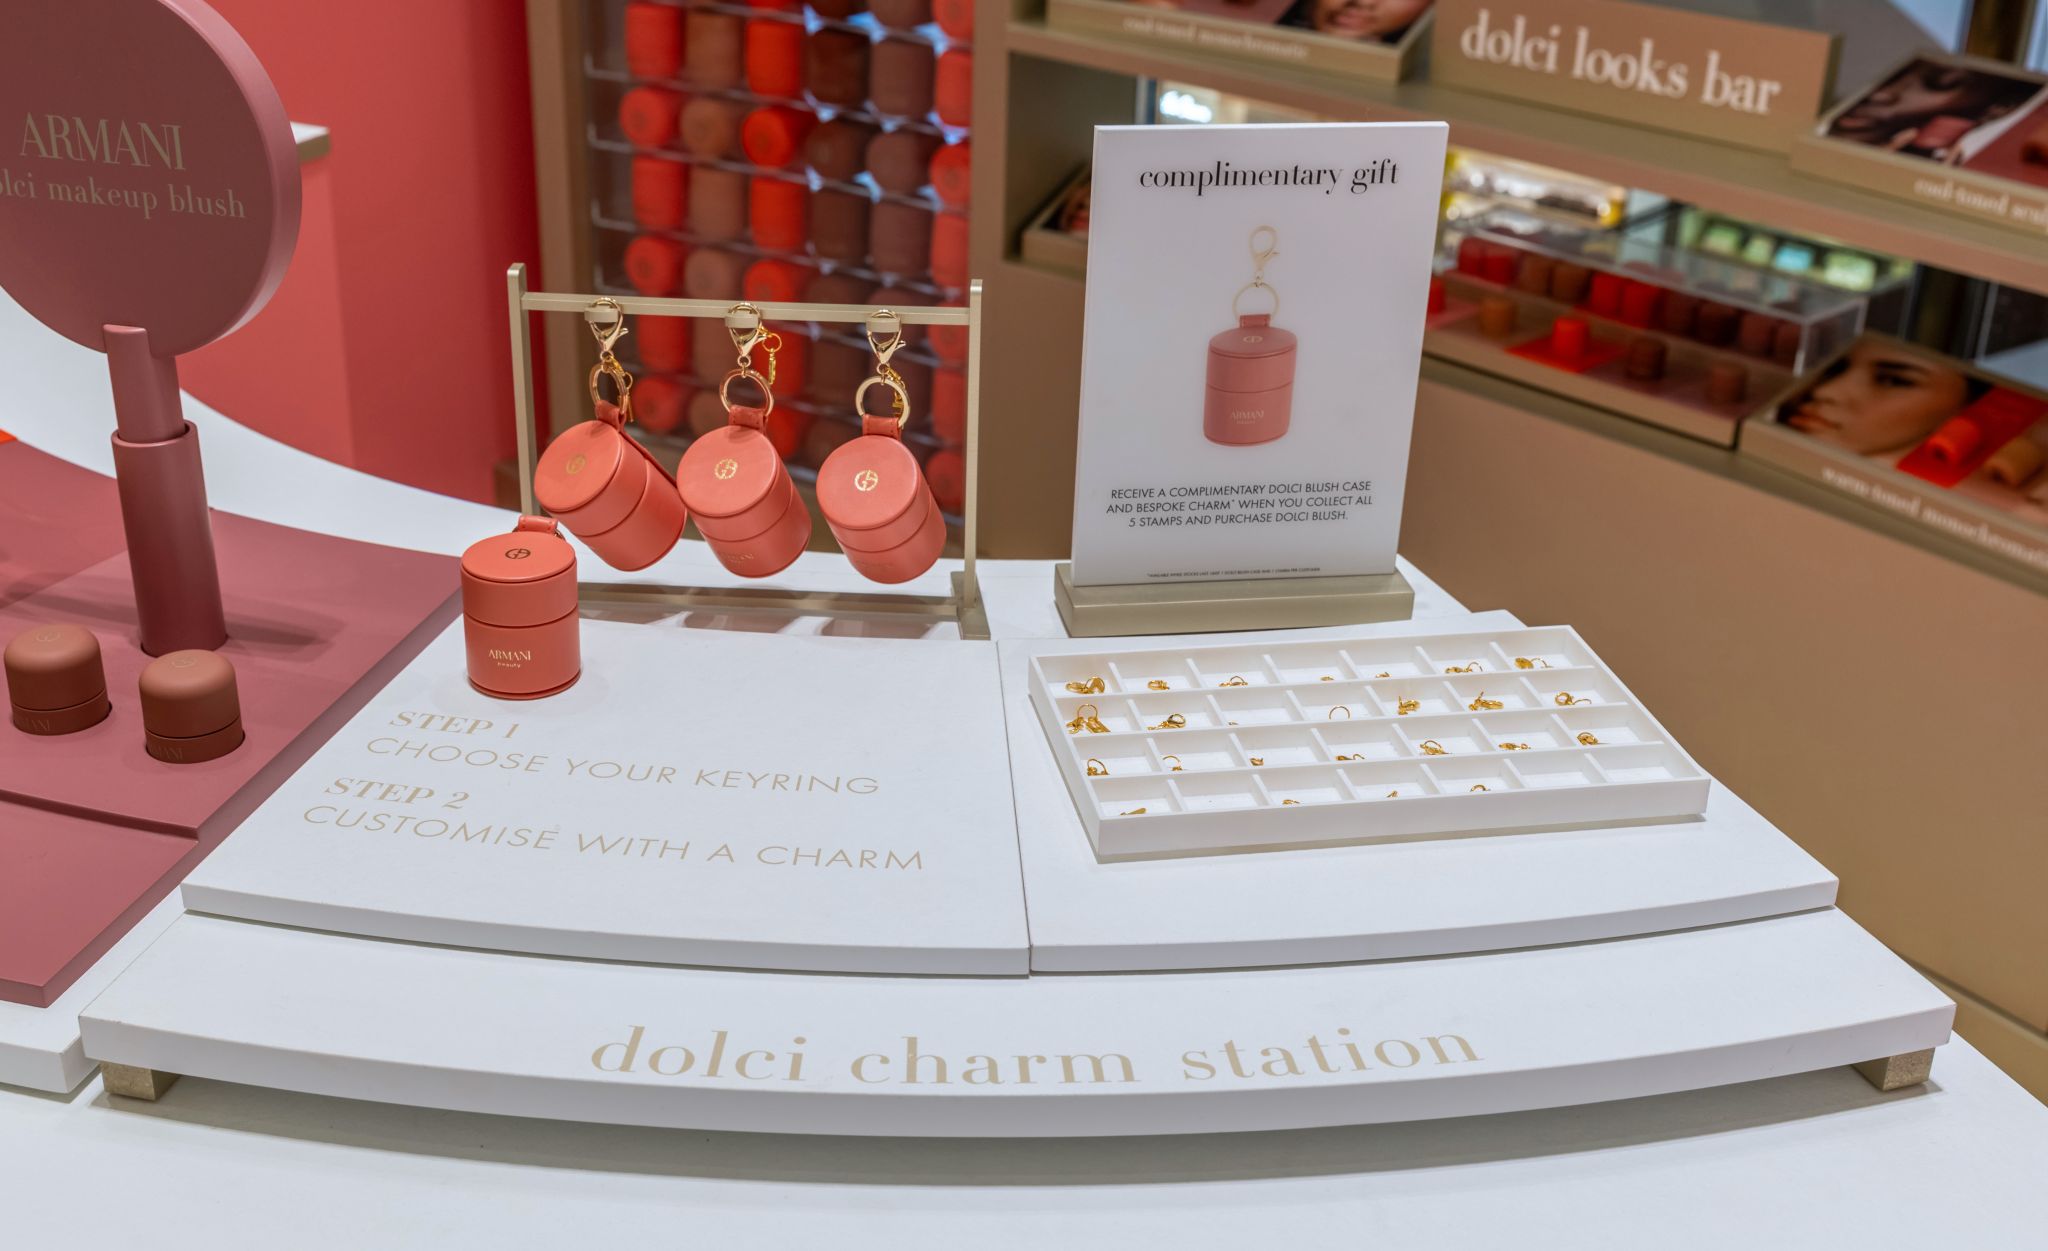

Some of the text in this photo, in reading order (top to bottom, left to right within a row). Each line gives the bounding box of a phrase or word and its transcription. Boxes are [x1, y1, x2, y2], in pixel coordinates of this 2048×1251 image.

[1460, 8, 1782, 114] dolci looks bar
[19, 111, 186, 170] ARMANI
[1139, 158, 1399, 197] complimentary gift
[48, 176, 158, 220] makeup
[168, 183, 247, 219] blush
[1106, 503, 1133, 514] AND
[1136, 501, 1185, 513] BESPOKE
[1238, 498, 1275, 509] WHEN
[1278, 497, 1303, 508] YOU
[1305, 495, 1352, 507] COLLECT
[1355, 495, 1373, 505] ALL
[1111, 481, 1371, 499] RECEIVE A COMPLIMENTARY DOLCI BLUSH CASE
[1128, 510, 1348, 527] 5 STAMPS AND PURCHASE DOLCI BLUSH.
[488, 648, 531, 661] ARMANI
[389, 710, 521, 740] STEP 1
[366, 736, 881, 795] CHOOSE YOUR KEYRING
[324, 776, 471, 810] STEP 2
[302, 804, 923, 871] CUSTOMISE WITH A CHARM
[590, 1024, 1485, 1085] dolci charm station
